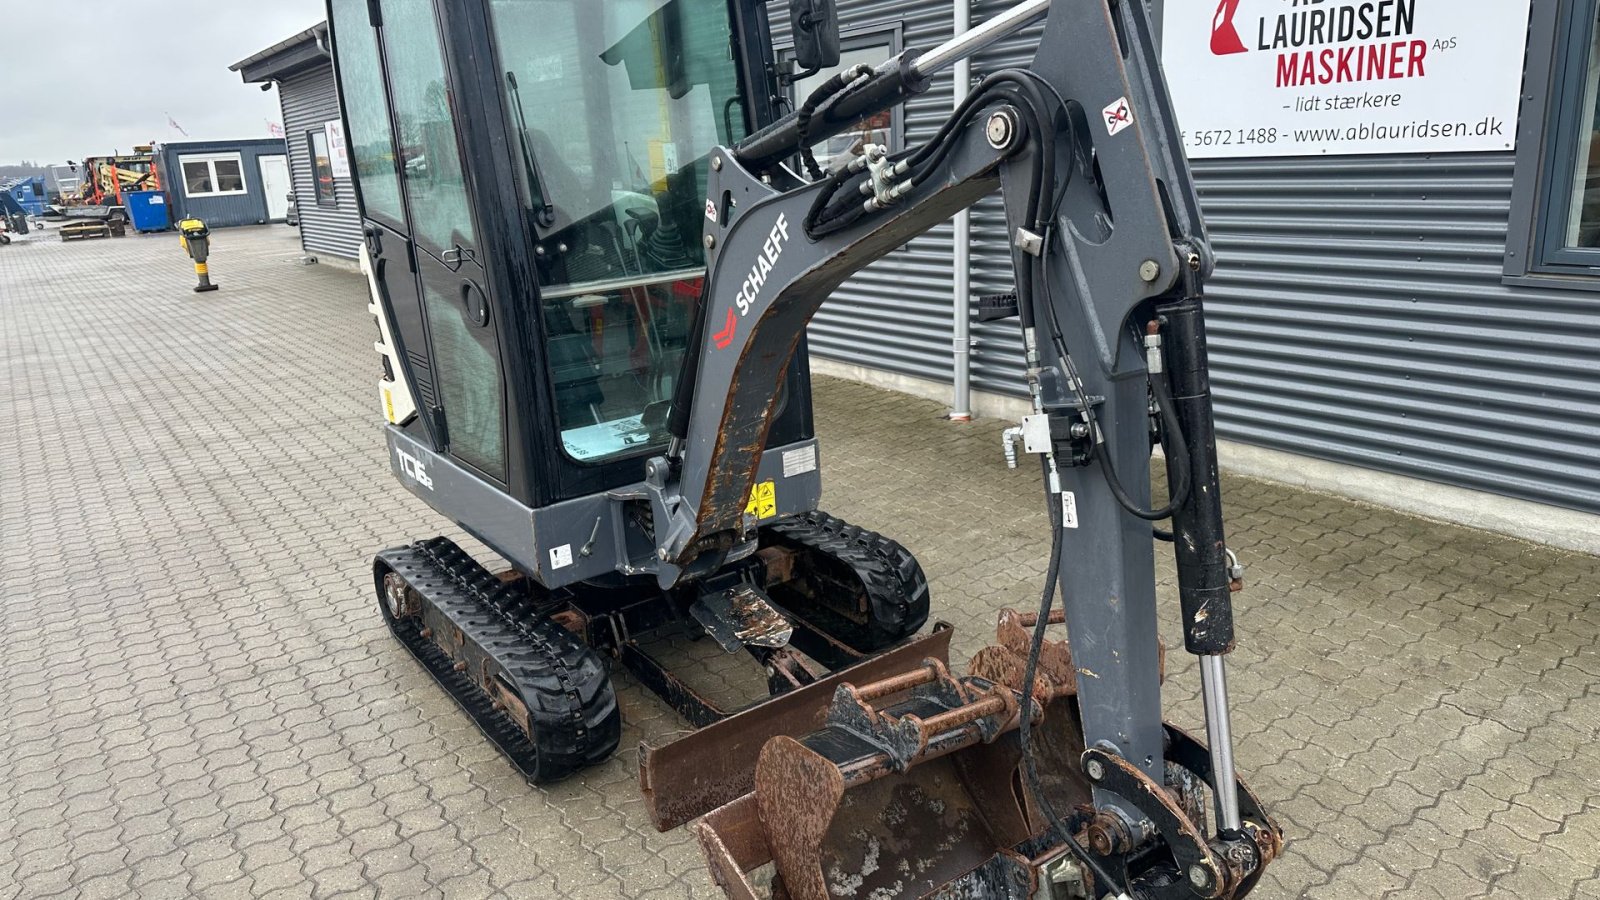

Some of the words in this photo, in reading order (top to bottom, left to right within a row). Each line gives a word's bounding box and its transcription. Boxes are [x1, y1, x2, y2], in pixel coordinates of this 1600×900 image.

[1258, 0, 1415, 51] LAURIDSEN
[1276, 40, 1427, 88] MASKINER
[1432, 37, 1457, 52] ApS
[1295, 96, 1321, 112] lidt
[1325, 92, 1402, 111] stærkere
[1194, 129, 1232, 146] 5672
[1236, 127, 1277, 145] 1488
[1294, 117, 1503, 142] www.ablauridsen.dk
[736, 212, 789, 316] SCHAEFF
